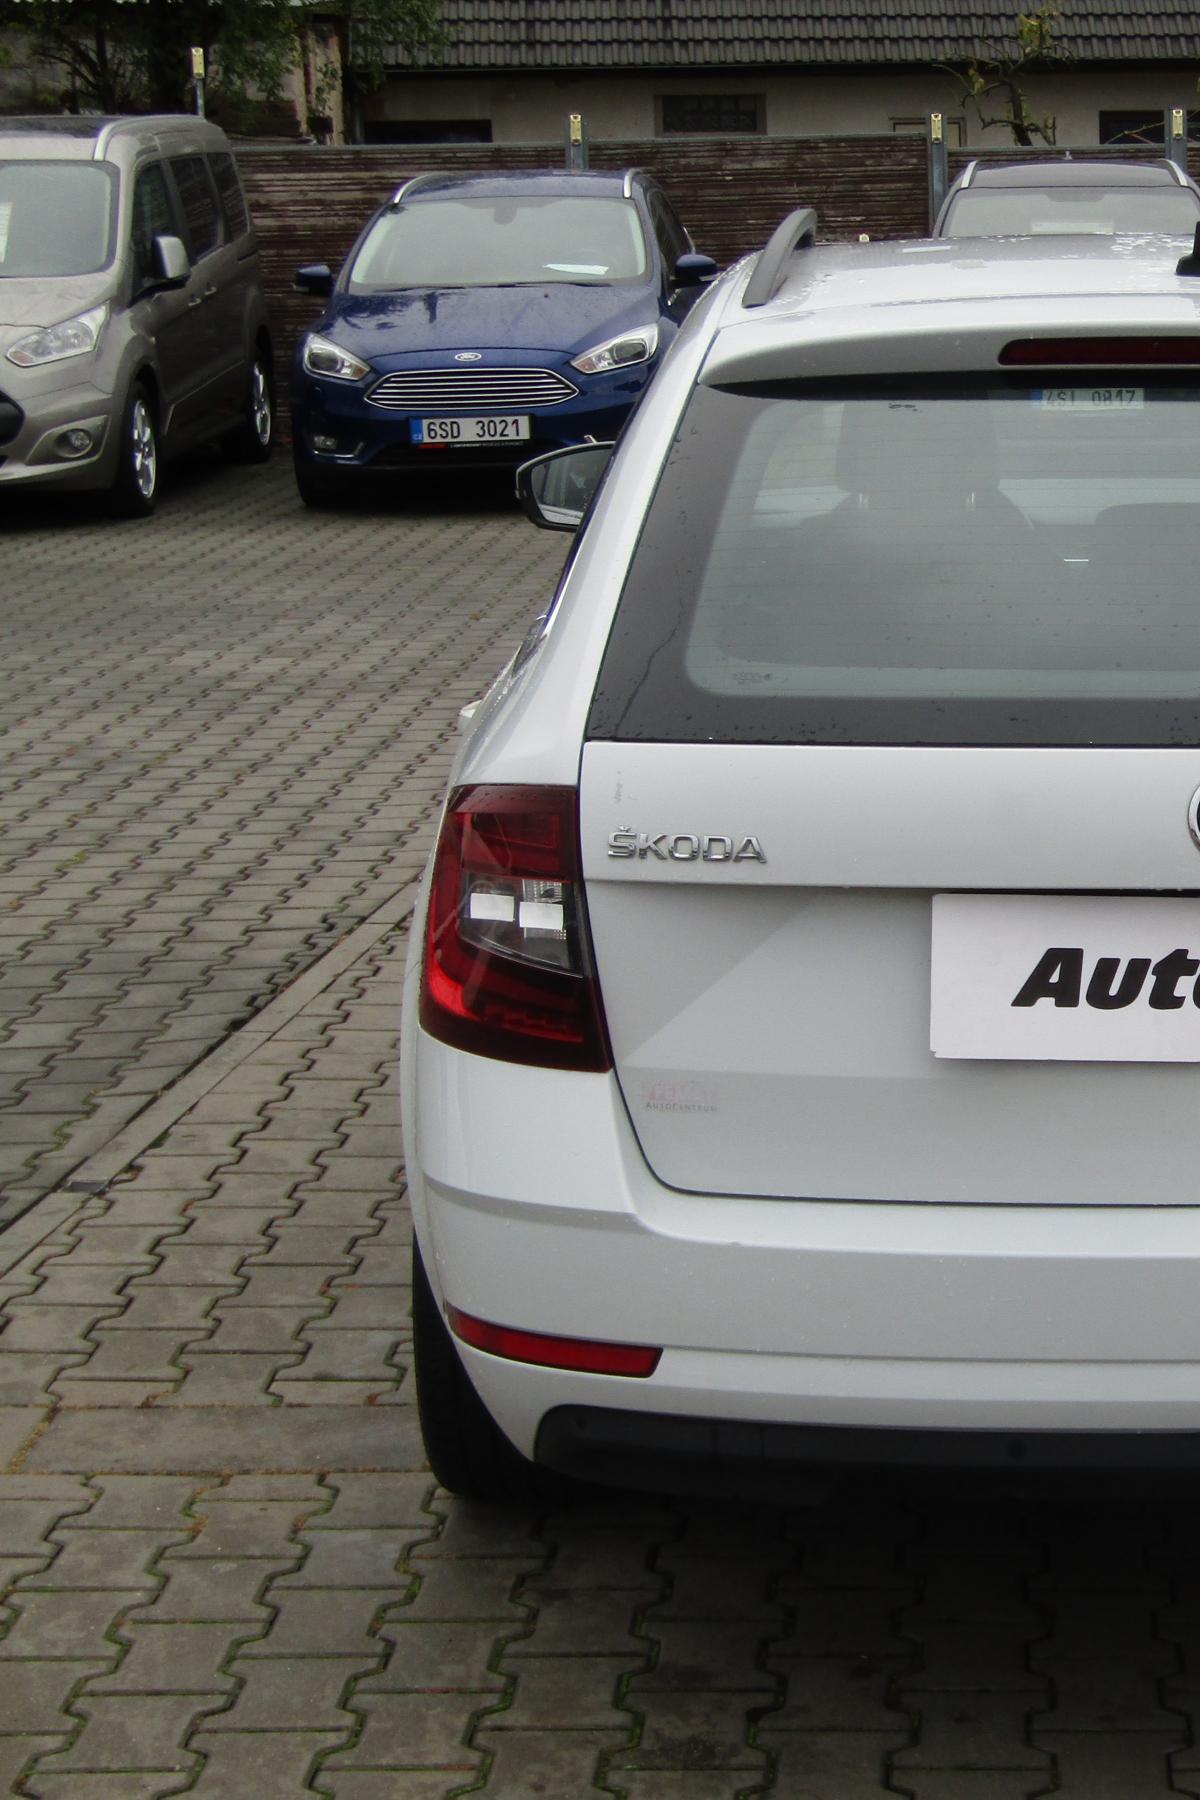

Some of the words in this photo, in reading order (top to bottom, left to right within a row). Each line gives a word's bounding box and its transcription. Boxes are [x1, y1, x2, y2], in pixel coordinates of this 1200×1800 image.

[427, 421, 461, 439] 6SD
[475, 418, 520, 438] 3021
[607, 825, 767, 863] ŠKODA
